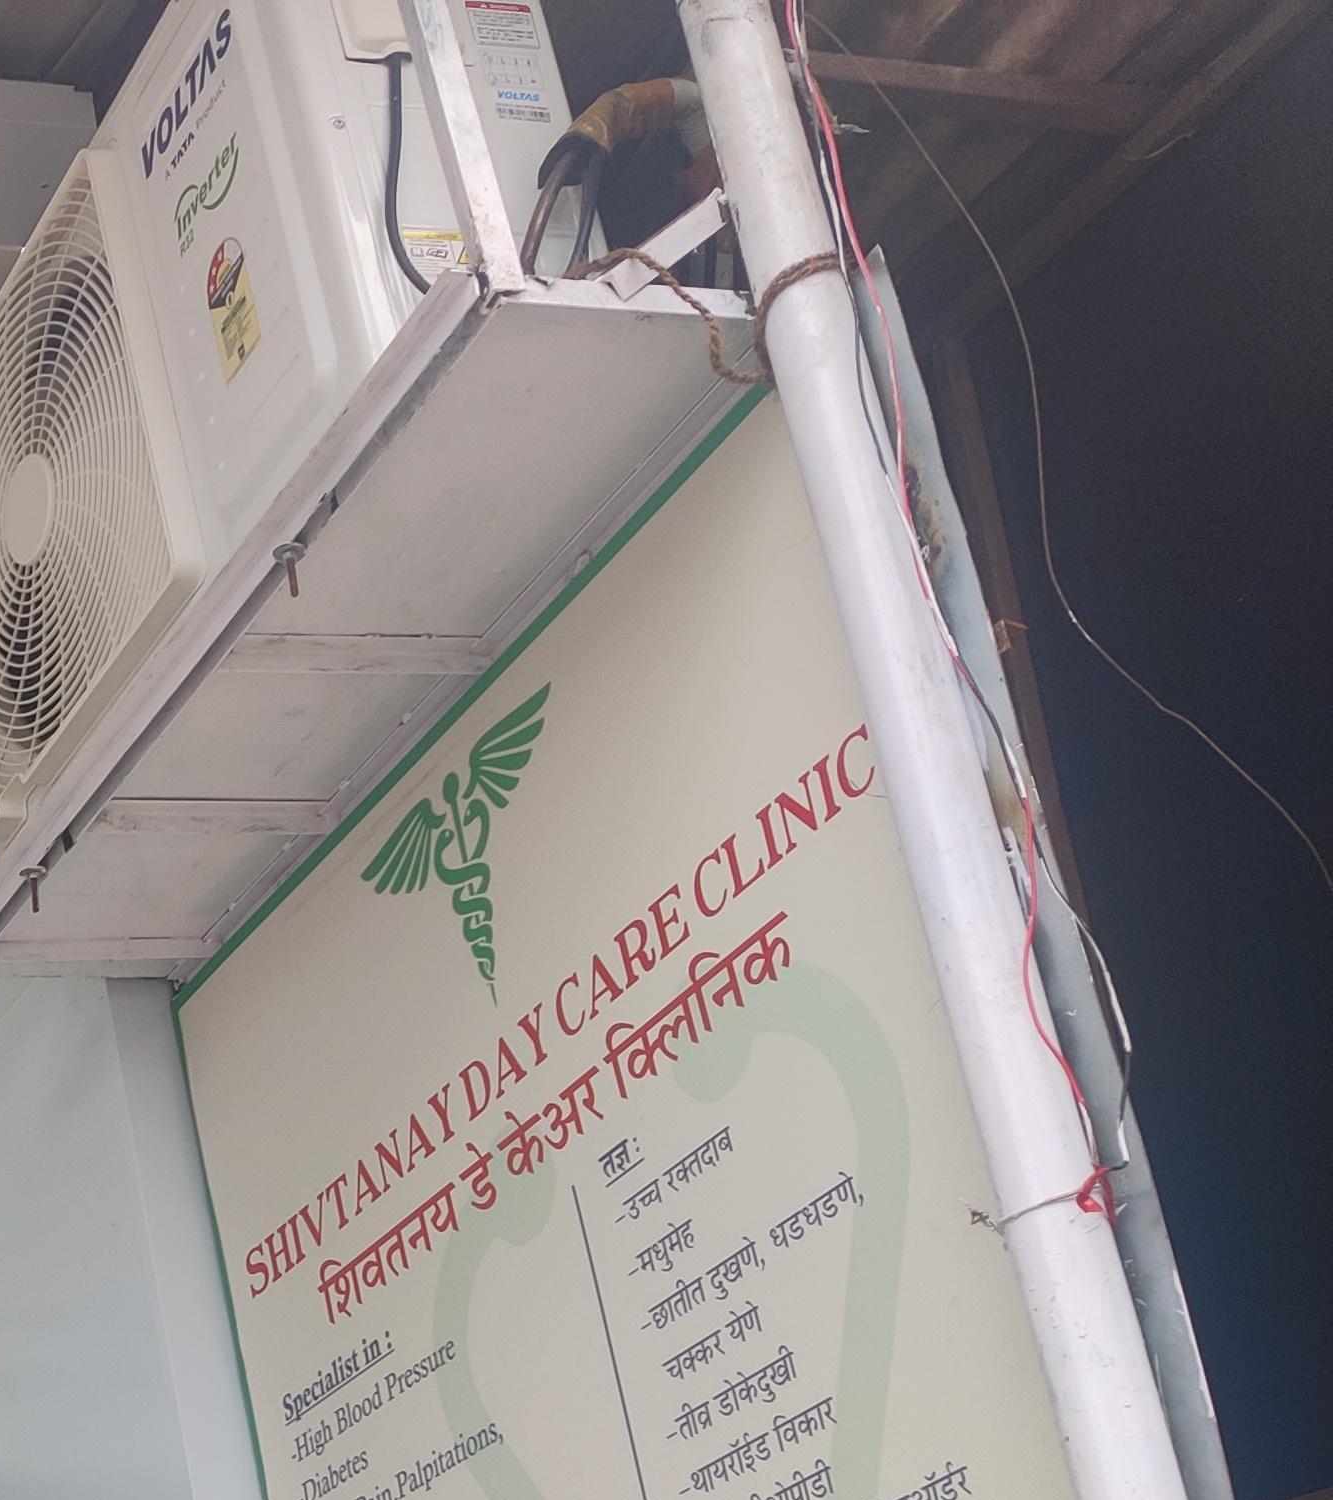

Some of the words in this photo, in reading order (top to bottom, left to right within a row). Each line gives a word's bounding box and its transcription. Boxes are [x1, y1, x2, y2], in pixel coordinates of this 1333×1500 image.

[141, 8, 232, 180] VOLTAS
[496, 89, 541, 102] VOLTAS
[244, 1081, 460, 1299] SHIVTANAY
[459, 1001, 552, 1120] DAY
[553, 884, 691, 1036] CARE
[692, 723, 877, 918] CLINIC
[317, 1180, 460, 1325] शिवतनय
[459, 1142, 499, 1212] डे
[497, 1066, 608, 1180] केअर
[603, 909, 791, 1100] क्लिनिक
[662, 1126, 733, 1192] रक्तदाब
[628, 1218, 695, 1277] -मधुमेह
[769, 1171, 865, 1249] धडधडणे,
[283, 1356, 360, 1424] Specialist
[362, 1338, 383, 1367] in
[662, 1330, 726, 1380] चक्कर
[725, 1301, 763, 1344] येणे
[291, 1420, 334, 1463] -High
[333, 1383, 383, 1437] Blood
[384, 1340, 457, 1403] Pressure
